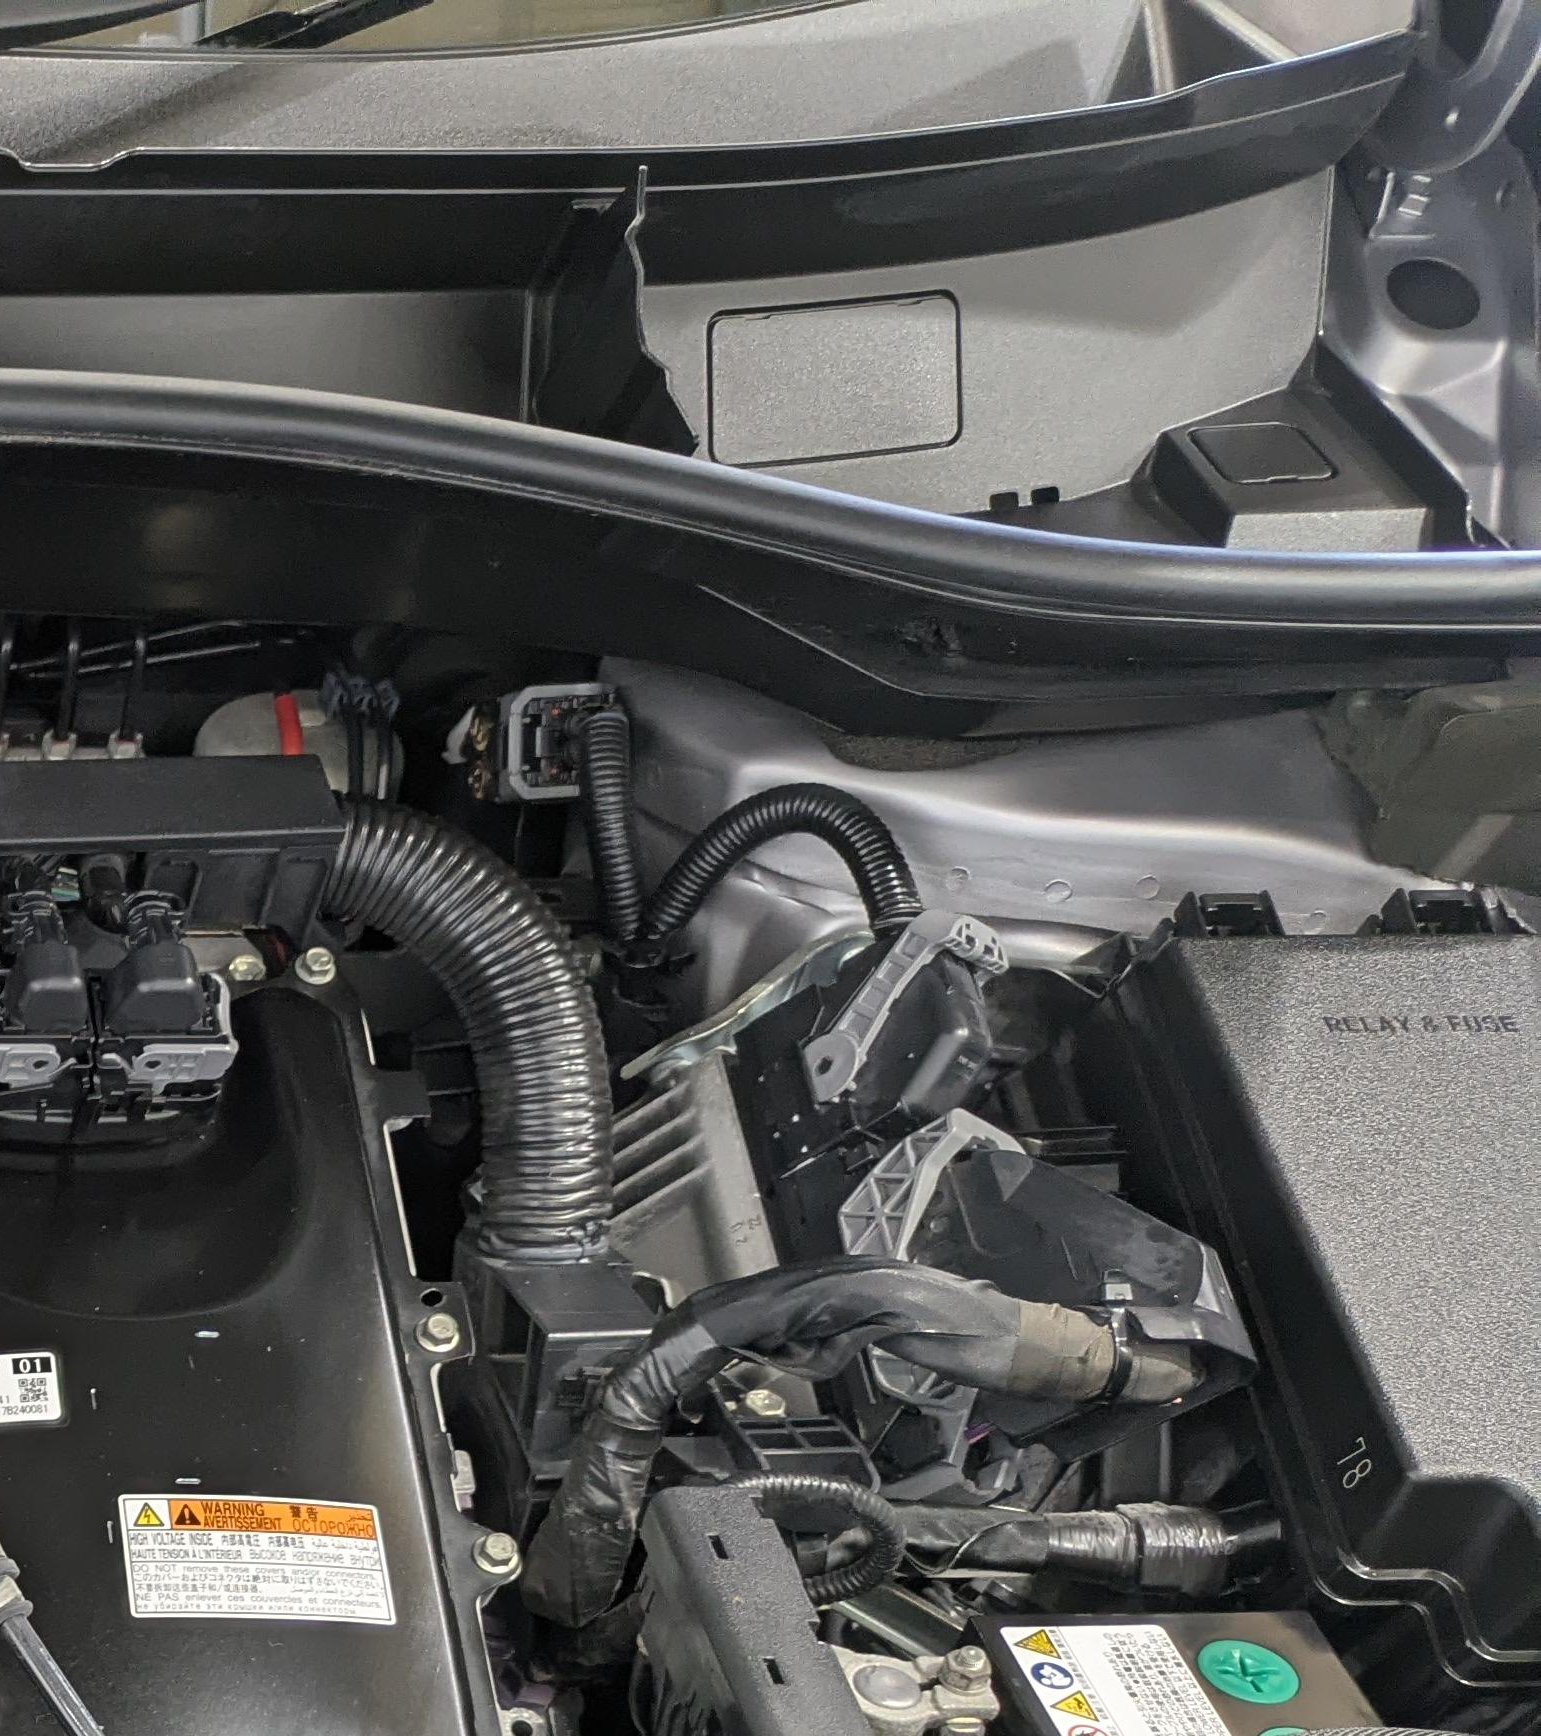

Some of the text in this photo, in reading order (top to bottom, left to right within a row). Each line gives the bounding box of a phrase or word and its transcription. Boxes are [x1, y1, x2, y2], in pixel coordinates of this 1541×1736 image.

[1322, 1015, 1409, 1034] RELAY
[1446, 1014, 1519, 1032] FUSE
[18, 1358, 42, 1374] 01
[200, 1502, 265, 1517] WARNING
[203, 1516, 282, 1530] AVERTISSEMENT
[292, 1520, 374, 1537] ОСТОРОЖНО
[129, 1533, 213, 1547] HIGH VOLTAGE INSIDE
[131, 1548, 156, 1559] HAUTE
[158, 1548, 190, 1559] TENSION
[132, 1564, 149, 1572] DO
[155, 1564, 178, 1572] NOT
[183, 1565, 218, 1573] remove
[158, 1592, 179, 1601] PAS
[185, 1593, 222, 1602] enlever
[1192, 1693, 1214, 1714] LEVEL
